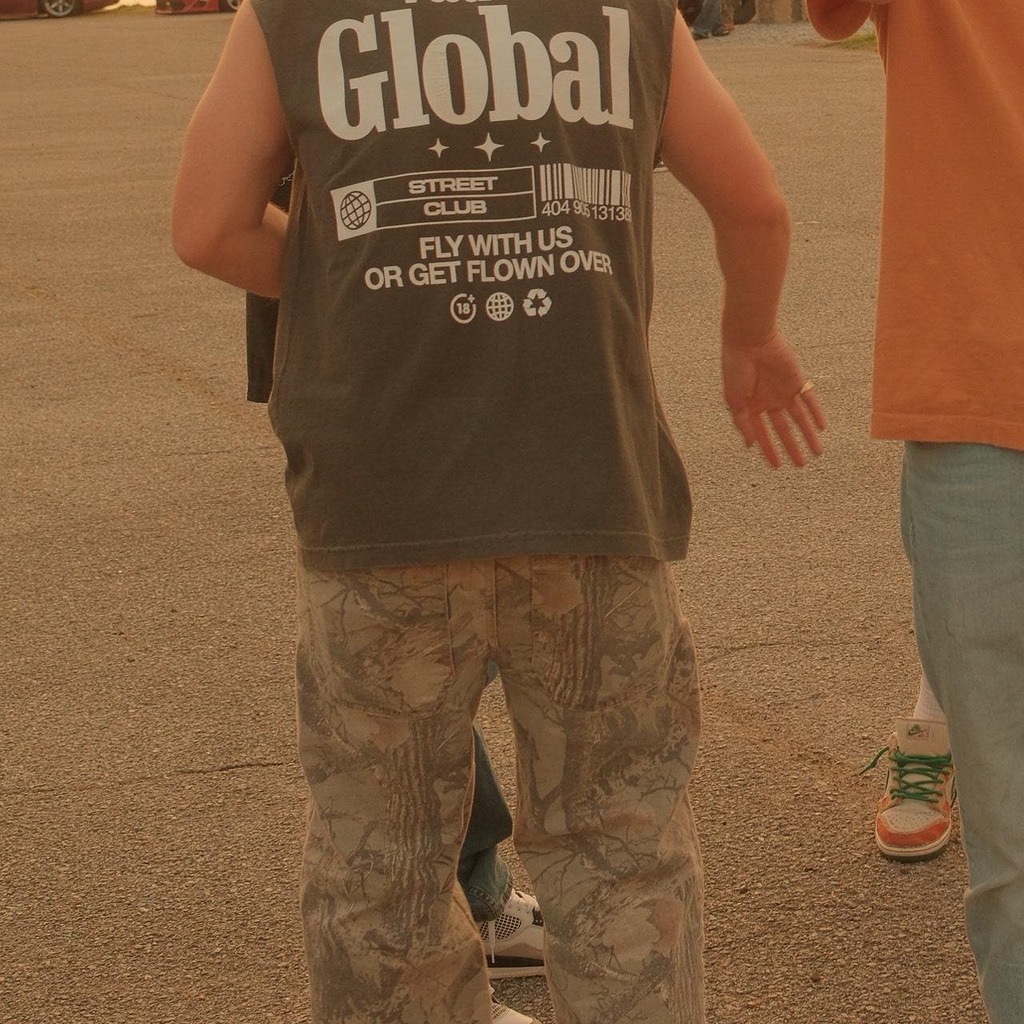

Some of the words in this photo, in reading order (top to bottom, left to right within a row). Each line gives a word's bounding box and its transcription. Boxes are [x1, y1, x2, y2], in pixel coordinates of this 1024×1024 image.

[317, 4, 634, 141] Global
[408, 176, 498, 194] STREET
[423, 200, 487, 216] CLUB
[541, 200, 571, 216] 404
[419, 234, 463, 259] FLY
[468, 230, 532, 257] WITH
[538, 225, 573, 249] US
[364, 265, 404, 290] OR
[408, 260, 462, 287] GET
[467, 253, 555, 283] FLOWN
[559, 250, 613, 275] OVER
